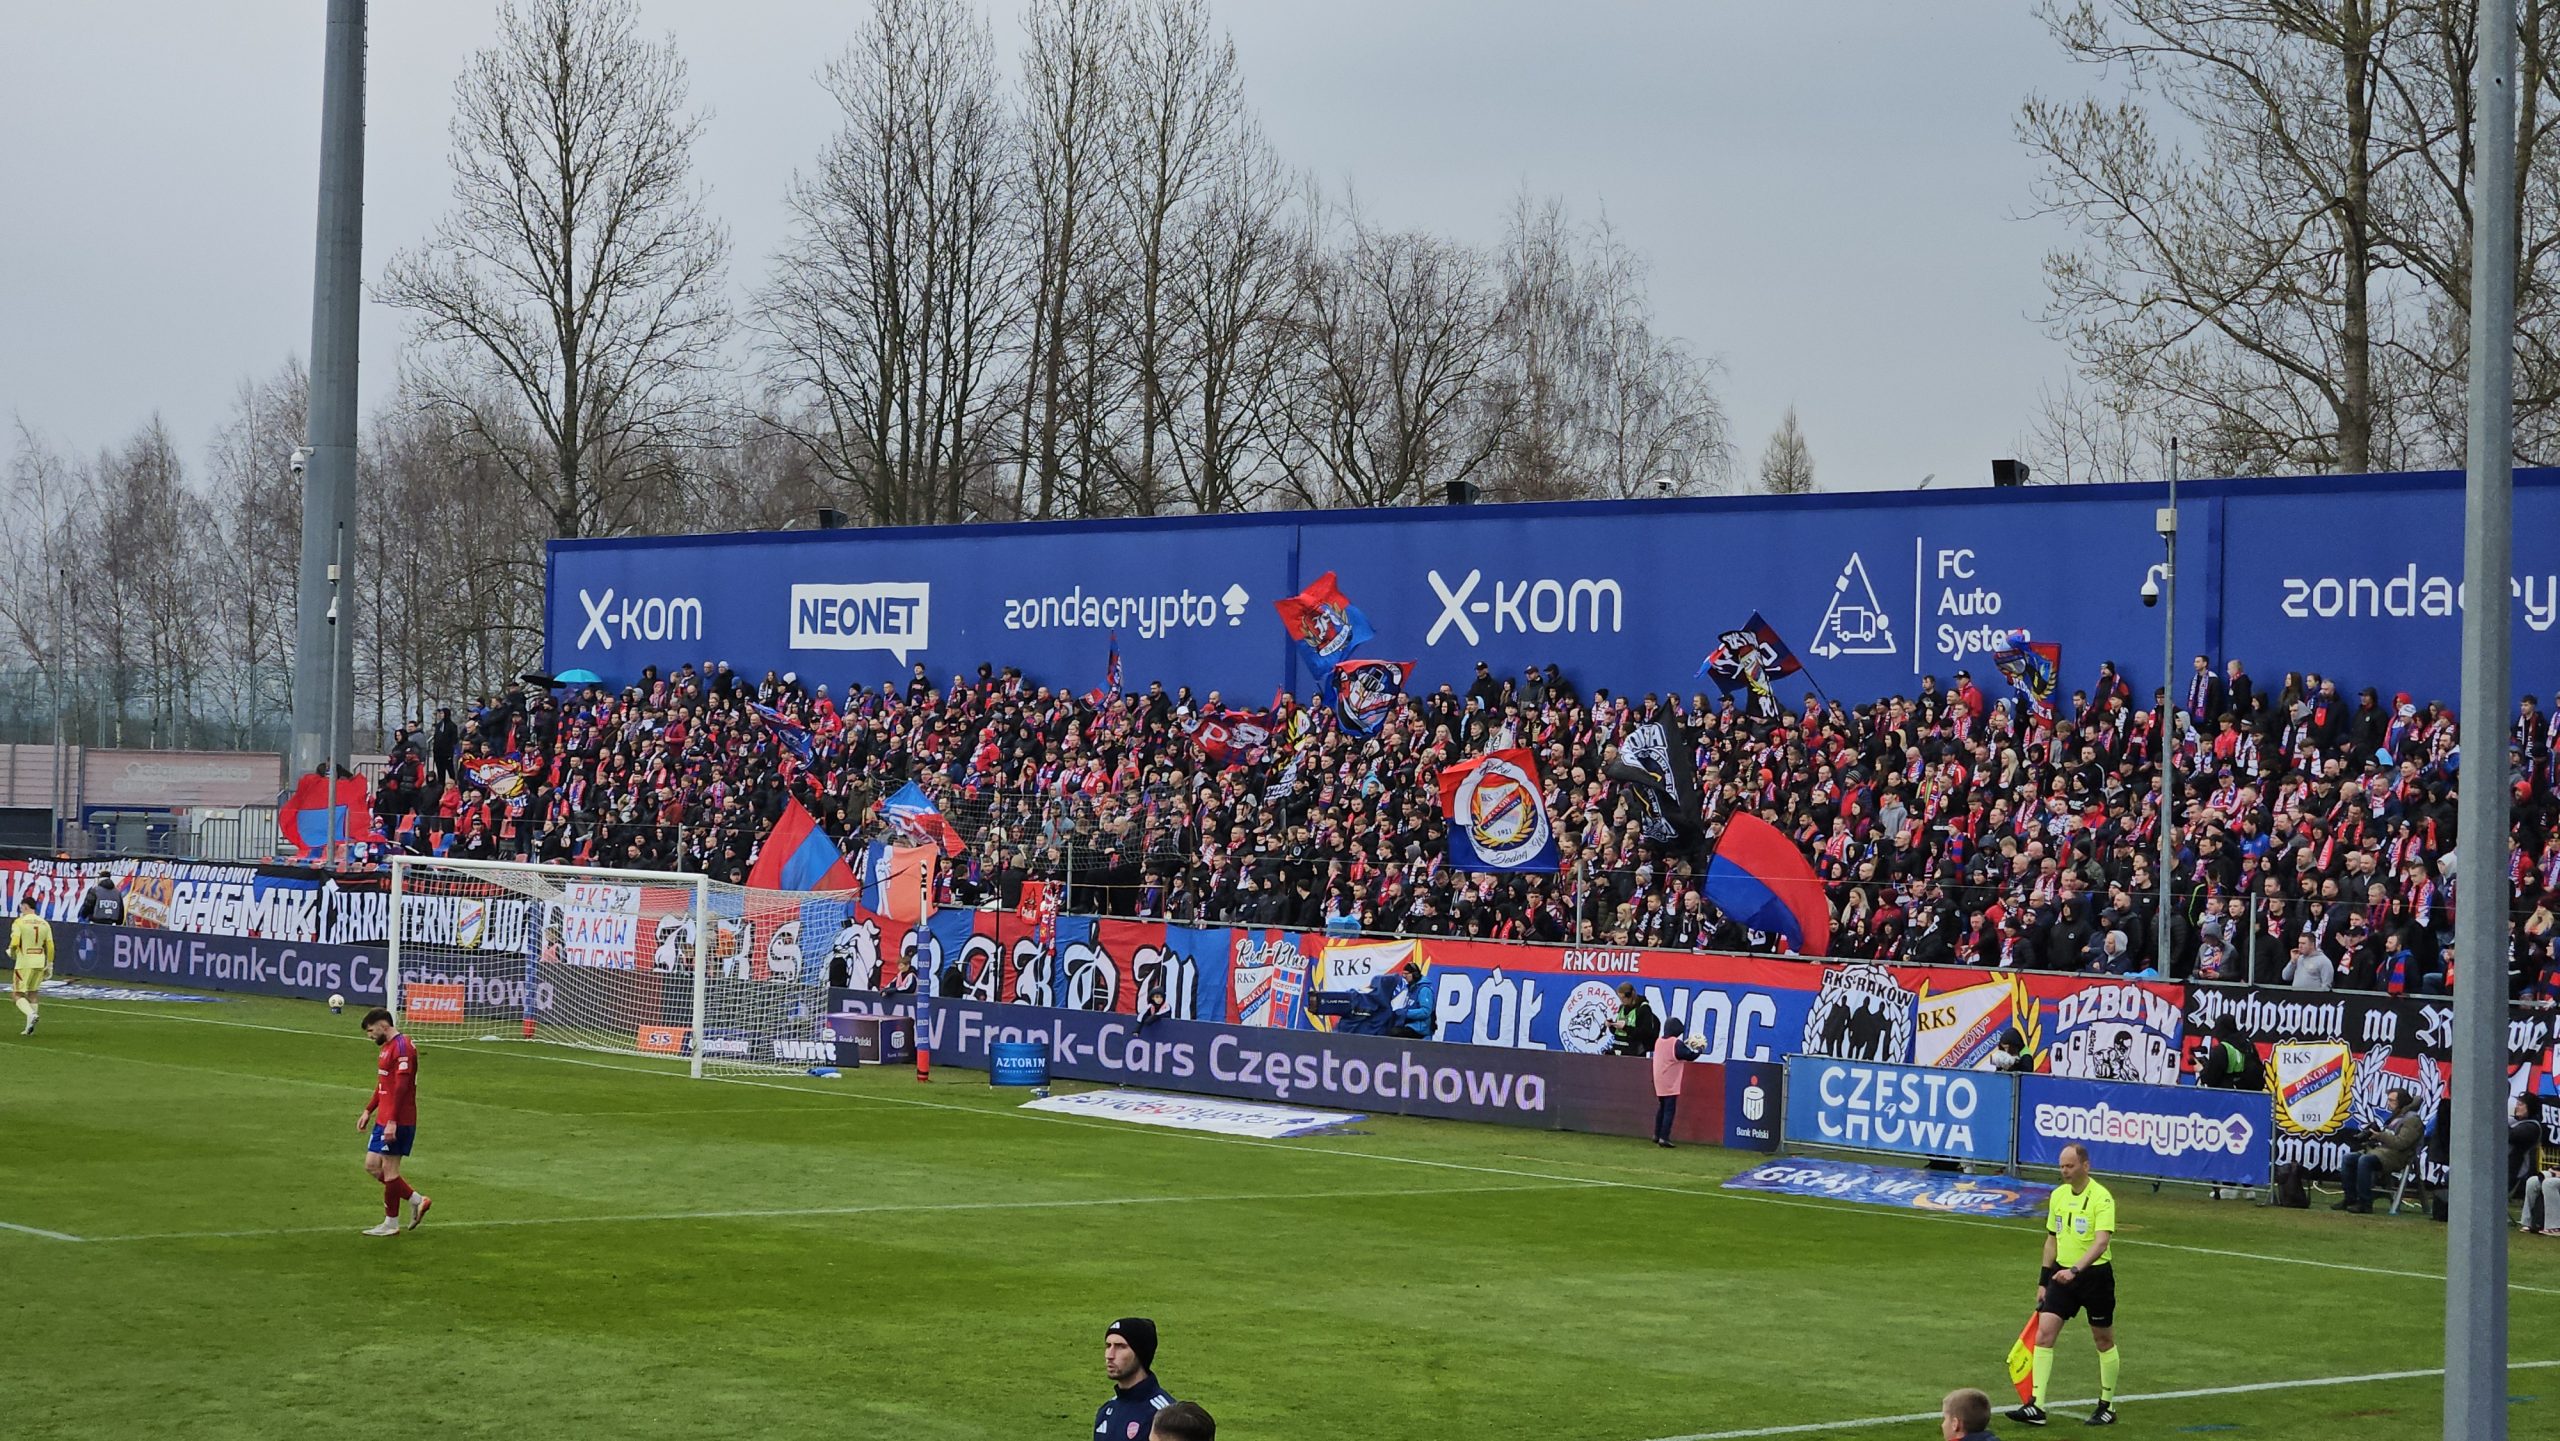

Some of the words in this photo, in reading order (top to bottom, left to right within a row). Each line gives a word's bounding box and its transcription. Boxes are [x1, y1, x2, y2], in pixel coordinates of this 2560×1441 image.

[1937, 549, 1975, 579] FC
[1937, 587, 2002, 616] Auto
[2281, 563, 2557, 631] zonday
[798, 598, 920, 635] NEONET
[1004, 586, 1217, 639] zondacrypto
[140, 860, 190, 879] WSPÓLNI
[190, 864, 257, 884] WROGOWIE
[99, 899, 118, 910] FOTO
[169, 881, 317, 943] CHEMIK
[318, 878, 459, 946] CHARATERNI
[33, 926, 39, 944] 1
[566, 914, 627, 944] RAKÓW
[114, 935, 183, 974] BMW
[189, 941, 341, 991] Frank-Cars
[350, 954, 554, 1011] Czstochowa
[1332, 956, 1372, 977] RKS
[1562, 950, 1641, 973] RAKOWIE
[1236, 973, 1256, 984] RKS
[1823, 970, 1855, 990] RKS
[410, 997, 462, 1011] STIHL
[1432, 967, 1547, 1050] PÓŁ
[1917, 1006, 1957, 1032] RKS
[2361, 1007, 2398, 1043] na
[958, 1010, 1195, 1078] Frank-Cars
[1209, 1033, 1546, 1111] Częstochowa
[996, 1057, 1046, 1068] AZTORIN
[2283, 1051, 2312, 1065] RKS
[2039, 1108, 2221, 1151] zondacrypto
[2301, 1113, 2322, 1122] 1921
[1736, 1126, 1751, 1138] Bank
[1751, 1127, 1769, 1140] Polski
